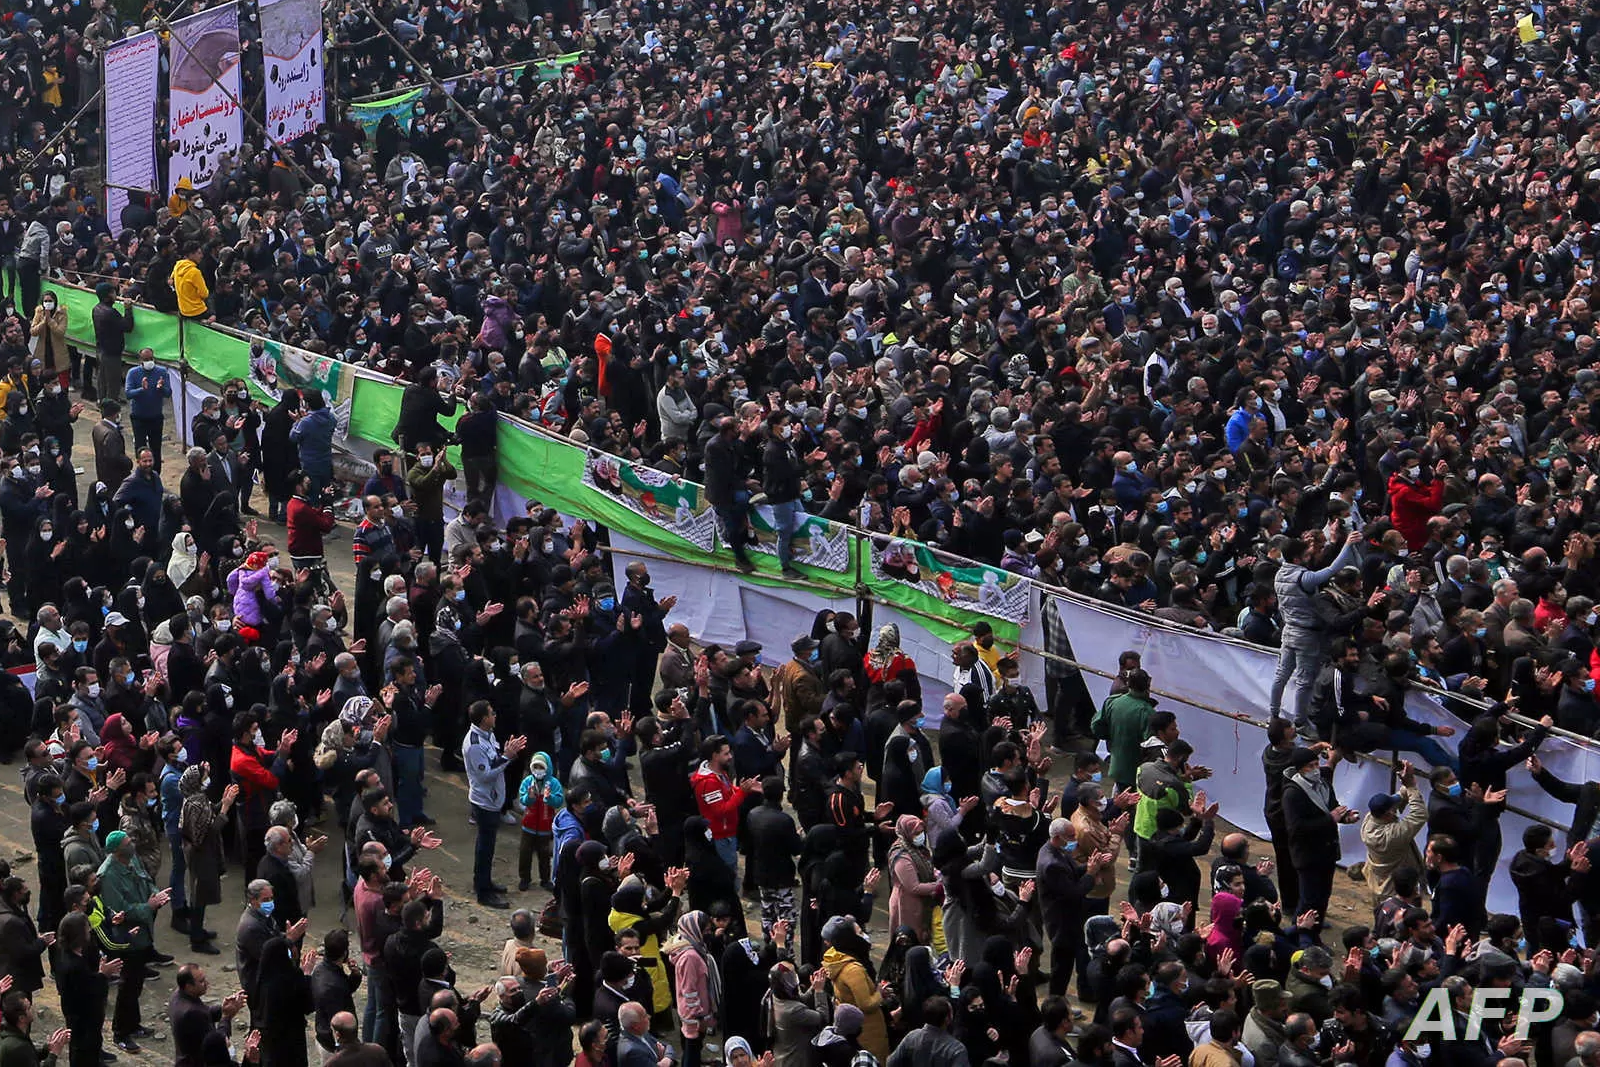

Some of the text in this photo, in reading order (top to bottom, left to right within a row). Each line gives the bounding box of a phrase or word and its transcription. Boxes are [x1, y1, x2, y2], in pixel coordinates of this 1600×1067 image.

[171, 88, 238, 135] فرونشست اصفهان
[305, 86, 322, 110] قربانی
[182, 131, 227, 162] یعنی سقوط
[375, 244, 393, 255] POLO
